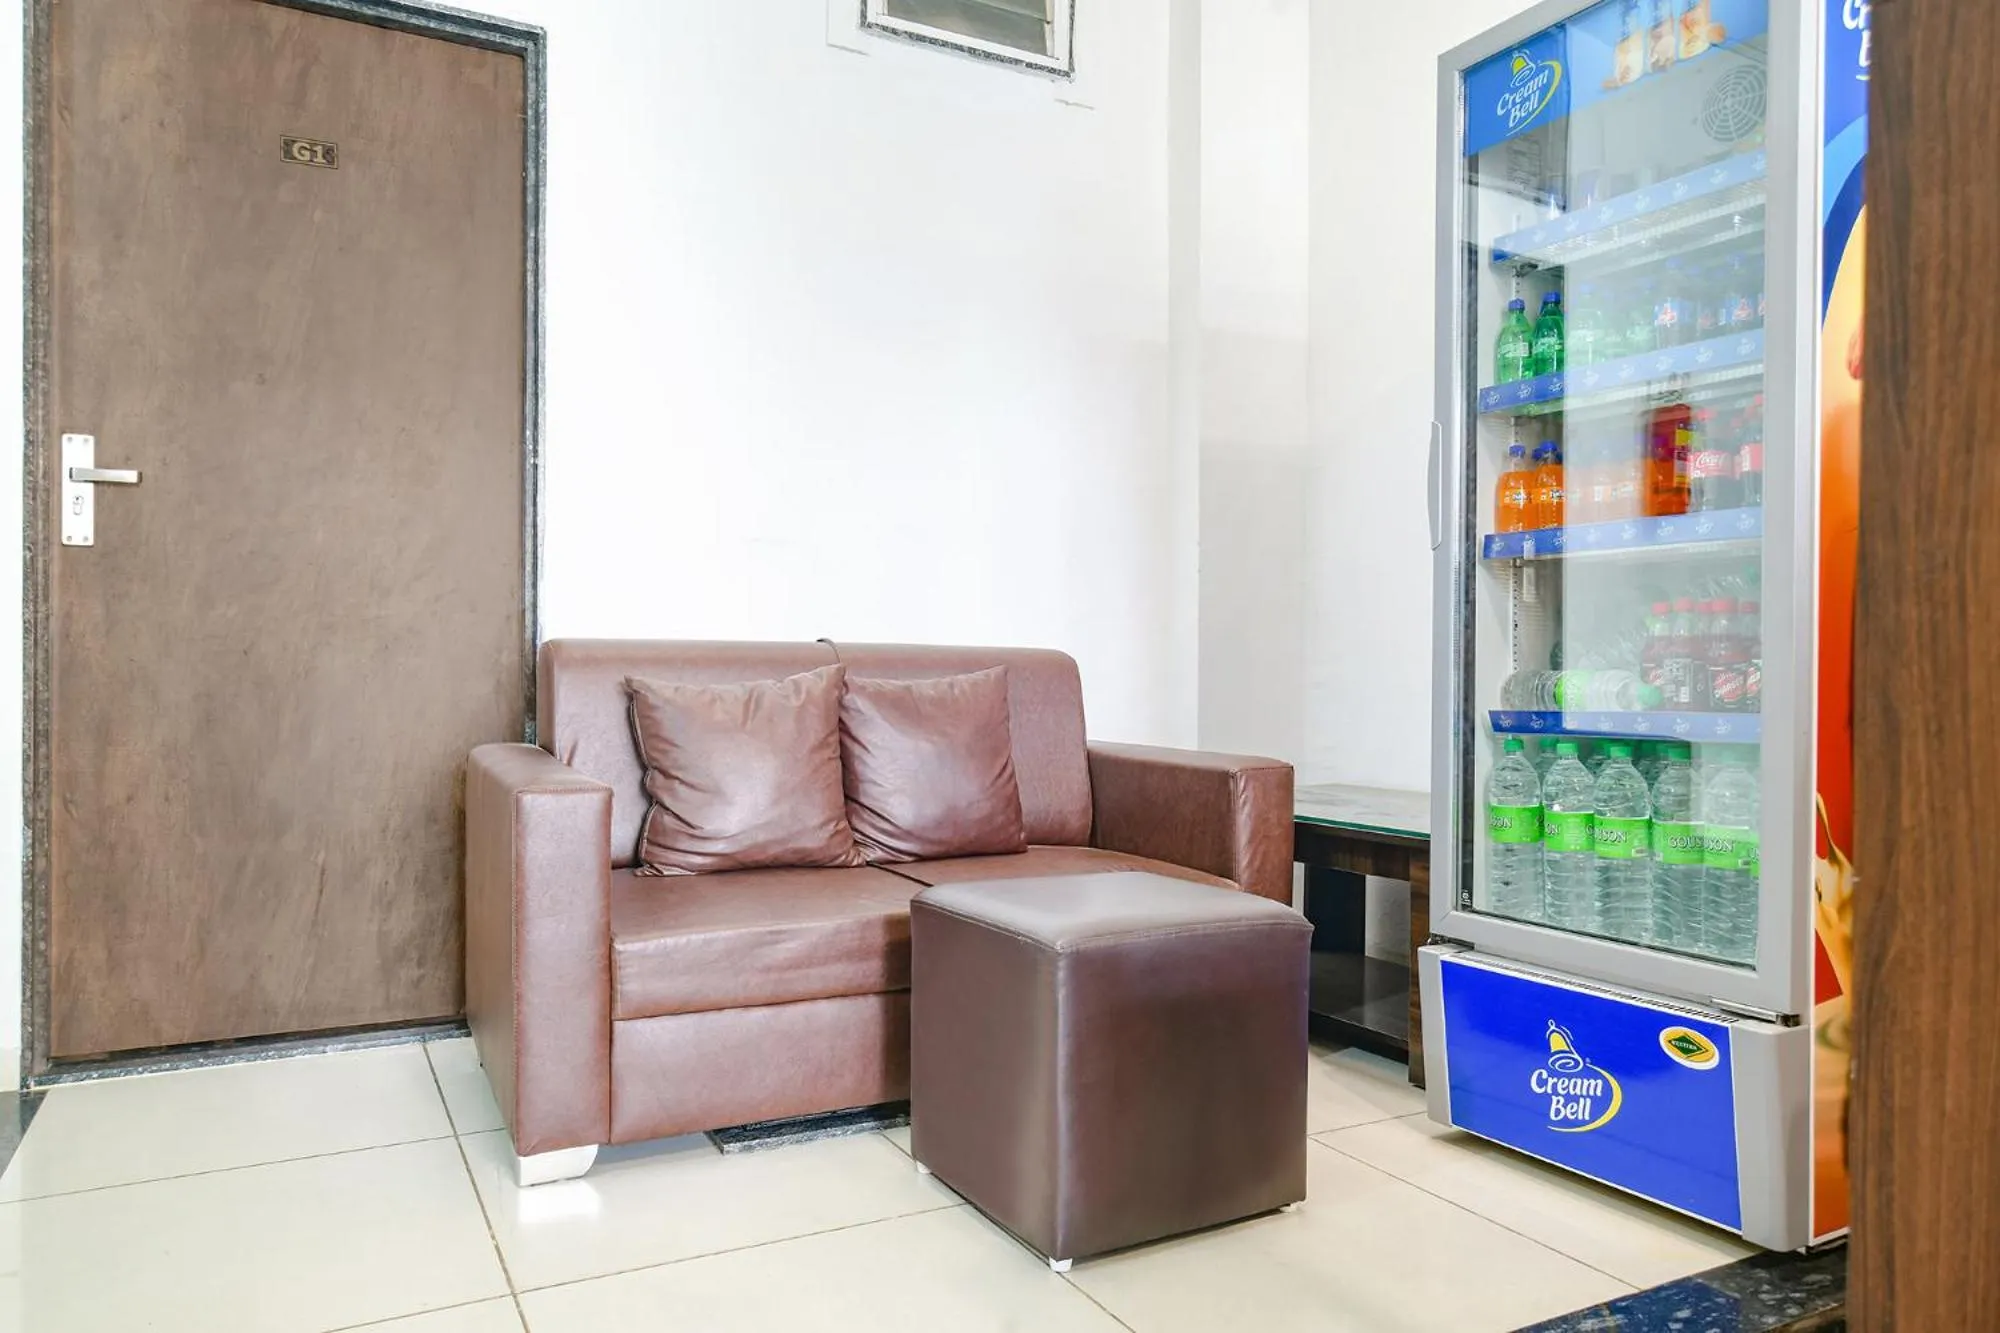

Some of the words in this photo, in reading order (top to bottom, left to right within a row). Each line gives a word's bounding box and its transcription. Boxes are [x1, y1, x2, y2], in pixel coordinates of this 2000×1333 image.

[1496, 69, 1549, 116] Cream
[1508, 90, 1540, 128] Bell
[292, 142, 326, 163] G1
[1530, 1068, 1603, 1097] Cream
[1549, 1095, 1592, 1121] Bell
